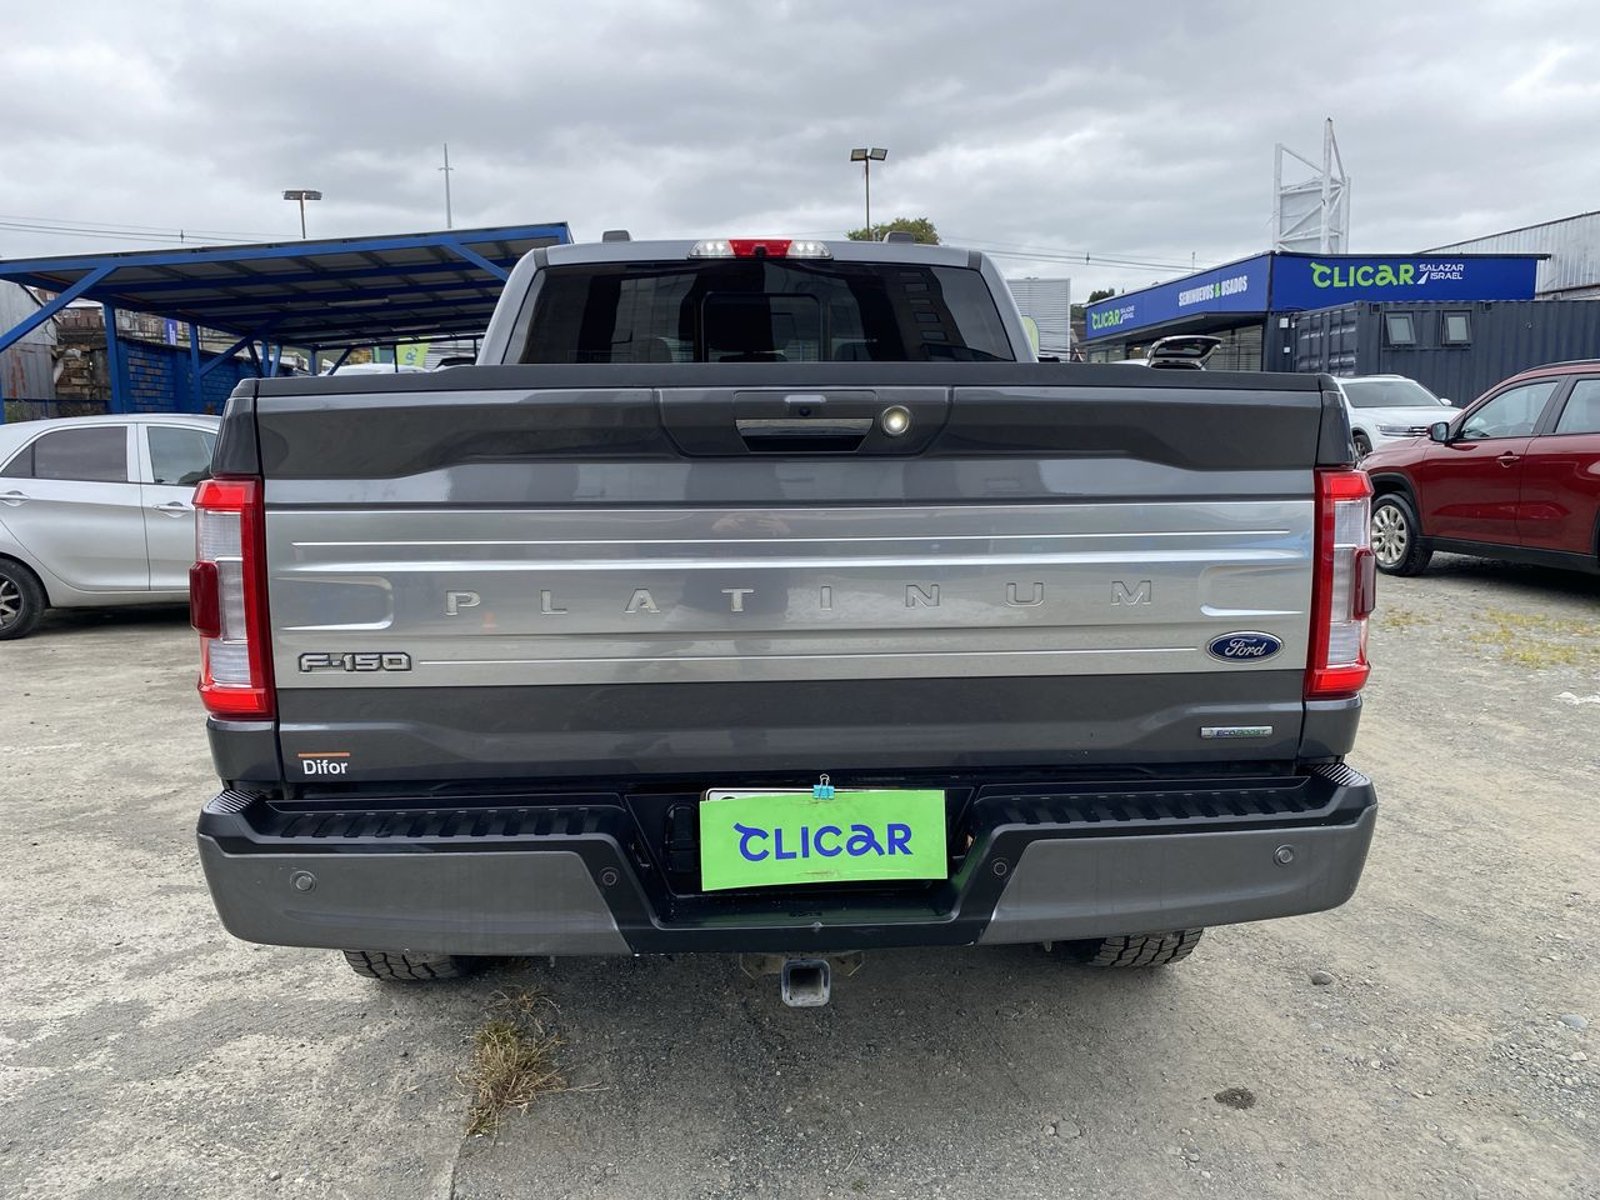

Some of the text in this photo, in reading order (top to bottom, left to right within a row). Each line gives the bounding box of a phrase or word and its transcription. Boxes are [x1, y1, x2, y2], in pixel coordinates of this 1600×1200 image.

[1419, 263, 1464, 272] SALAZAR
[1430, 272, 1463, 280] ISRAEL
[445, 580, 1152, 616] PLATINUM
[1224, 638, 1267, 656] Ford
[298, 652, 412, 673] F-150
[302, 759, 349, 775] Difor
